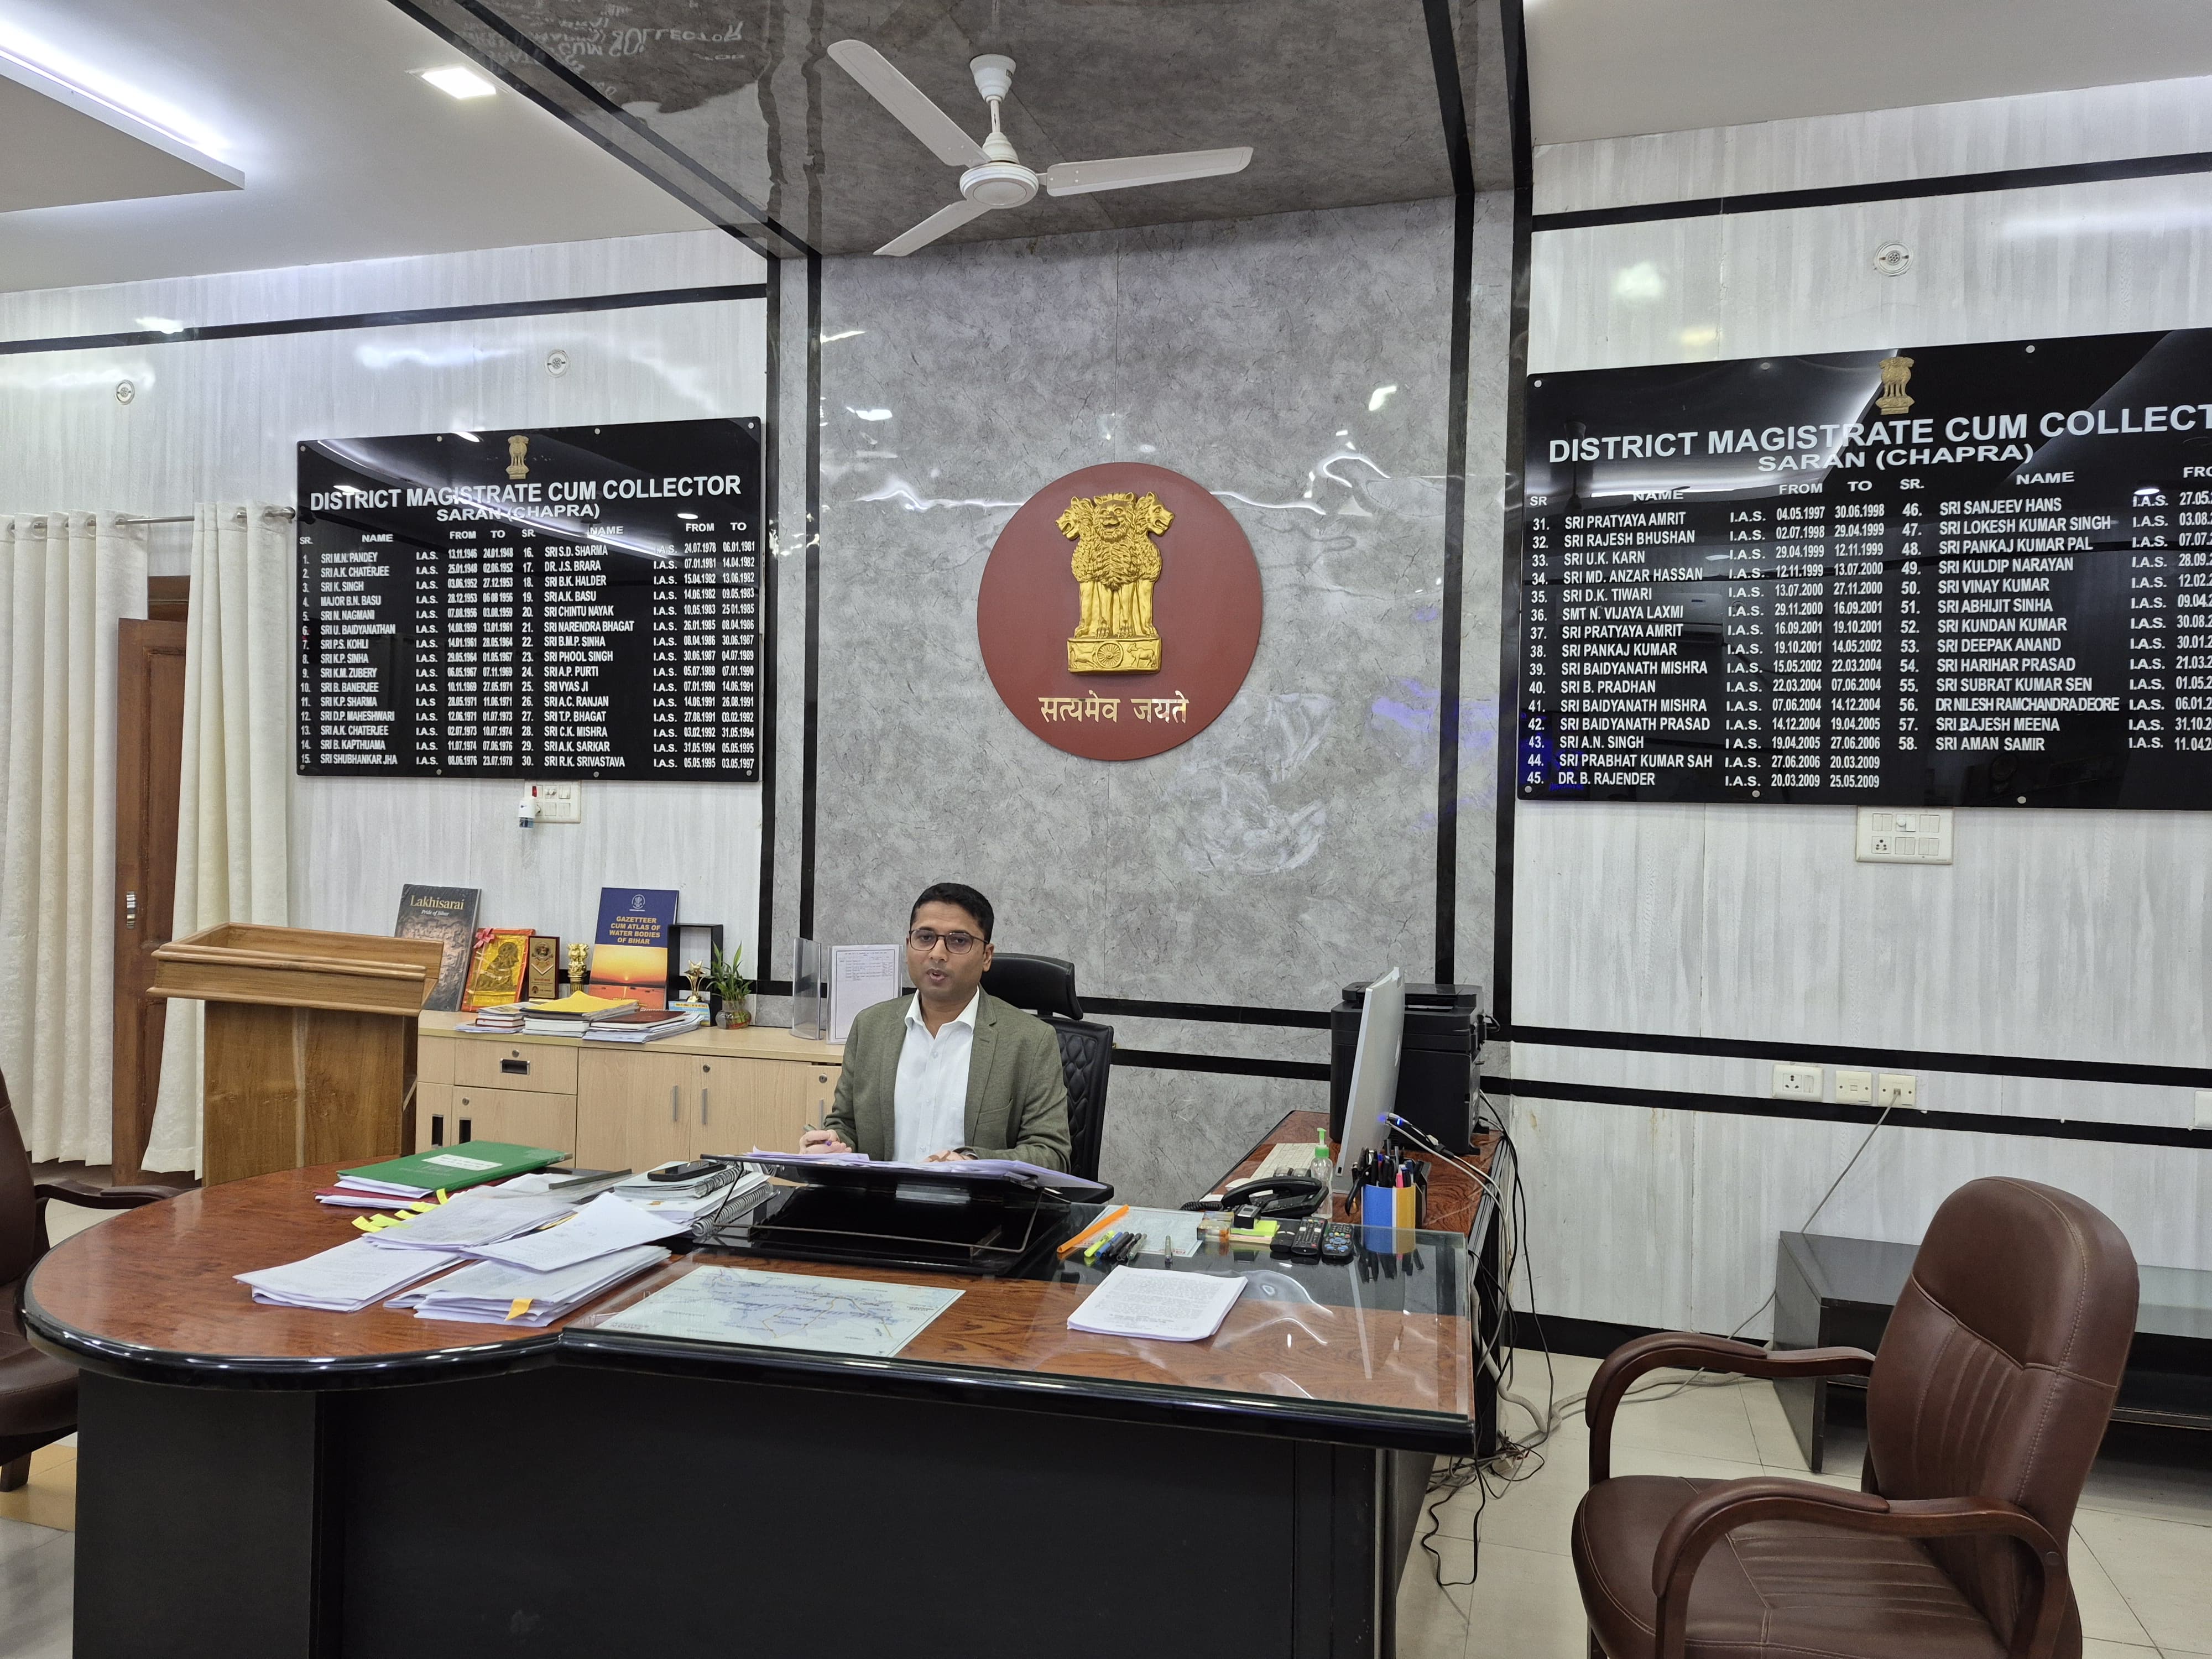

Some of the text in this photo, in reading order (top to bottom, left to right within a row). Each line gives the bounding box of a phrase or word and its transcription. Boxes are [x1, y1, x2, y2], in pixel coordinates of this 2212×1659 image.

[1549, 405, 2212, 462] DISTRICT MAGISTRATE CUM COLLECT
[1759, 444, 2033, 471] SARAN (CHAPRA)
[1900, 466, 2212, 489] SR. NAME FRO
[311, 475, 740, 510] DISTRICT MAGISTRATE CUM COLLECTOR
[1530, 481, 1872, 506] SR NAME FROM TO
[436, 503, 600, 522] SARAN (CHAPRA)
[589, 526, 623, 536] NAME
[685, 523, 714, 532] FROM
[731, 523, 747, 531] TO
[1902, 515, 2168, 536] 47. SRI LOKESH KUMAR SINGH I.A.S.
[362, 534, 393, 542] NAME
[450, 530, 477, 539] FROM
[491, 530, 505, 539] TO
[1533, 523, 1884, 549] 32. SRI RAJESH BHUSHAN I.A.S. 02.07.1998 29.04.1999
[523, 556, 754, 572] 17. DR. J.S. BRARA I.A.S. 07.01.1981 14.04.1982
[302, 577, 513, 592] 3. SRI K. SINGH I.A.S. 03.06.1952 27.12.1953
[1901, 577, 2167, 594] 50. SRI VINAY KUMAR I.A.S.
[1531, 582, 1882, 603] 35. SRI D.K. TIWARI I.A.S. 13.07.2000 27.11.2000
[302, 622, 513, 635] 6. SRI U. BAIDYANATHAN I.A.S. 14.08.1959 13.01.1961
[522, 619, 754, 632] 21. SRI NARENDRA BHAGAT I.A.S. 26.01.1985 08.04.1986
[522, 650, 754, 662] 23. SRI PHOOL SINGH I.A.S. 30.06.1987 04.07.1989
[301, 681, 513, 692] 10. SRI B. BANERJEE I.A.S. 10.11.1969 27.05.1971
[1529, 678, 1881, 693] 40. SRI B. PRADHAN I.A.S. 22.03.2004 07.06.2004
[1900, 677, 2164, 692] 55. SRI SUBRAT KUMAR SEN I.A.S.
[1038, 690, 1190, 724] सत्यमेव जयते
[301, 740, 311, 749] 14.
[321, 739, 332, 749] SRI
[333, 739, 340, 749] B.
[342, 739, 385, 750] KAPTHUAMA
[448, 740, 477, 750] 11.07.1974
[483, 741, 513, 751] 07.06.1976
[1899, 737, 2163, 750] 58. SRI AMAN SAMIR I.A.S.
[522, 756, 754, 769] 30. SRI R.K. SRIVASTAVA I.A.S. 05.05.1995 03.05.1997
[1528, 754, 1880, 769] 44. SRI PRABHAT KUMAR SAH I.A.S. 27.06.2006 20.03.2009
[1527, 771, 1879, 787] 45. DR. B. RAJENDER I.A.S. 20.03.2009 25.05.2009
[410, 895, 465, 910] Lakhisarai
